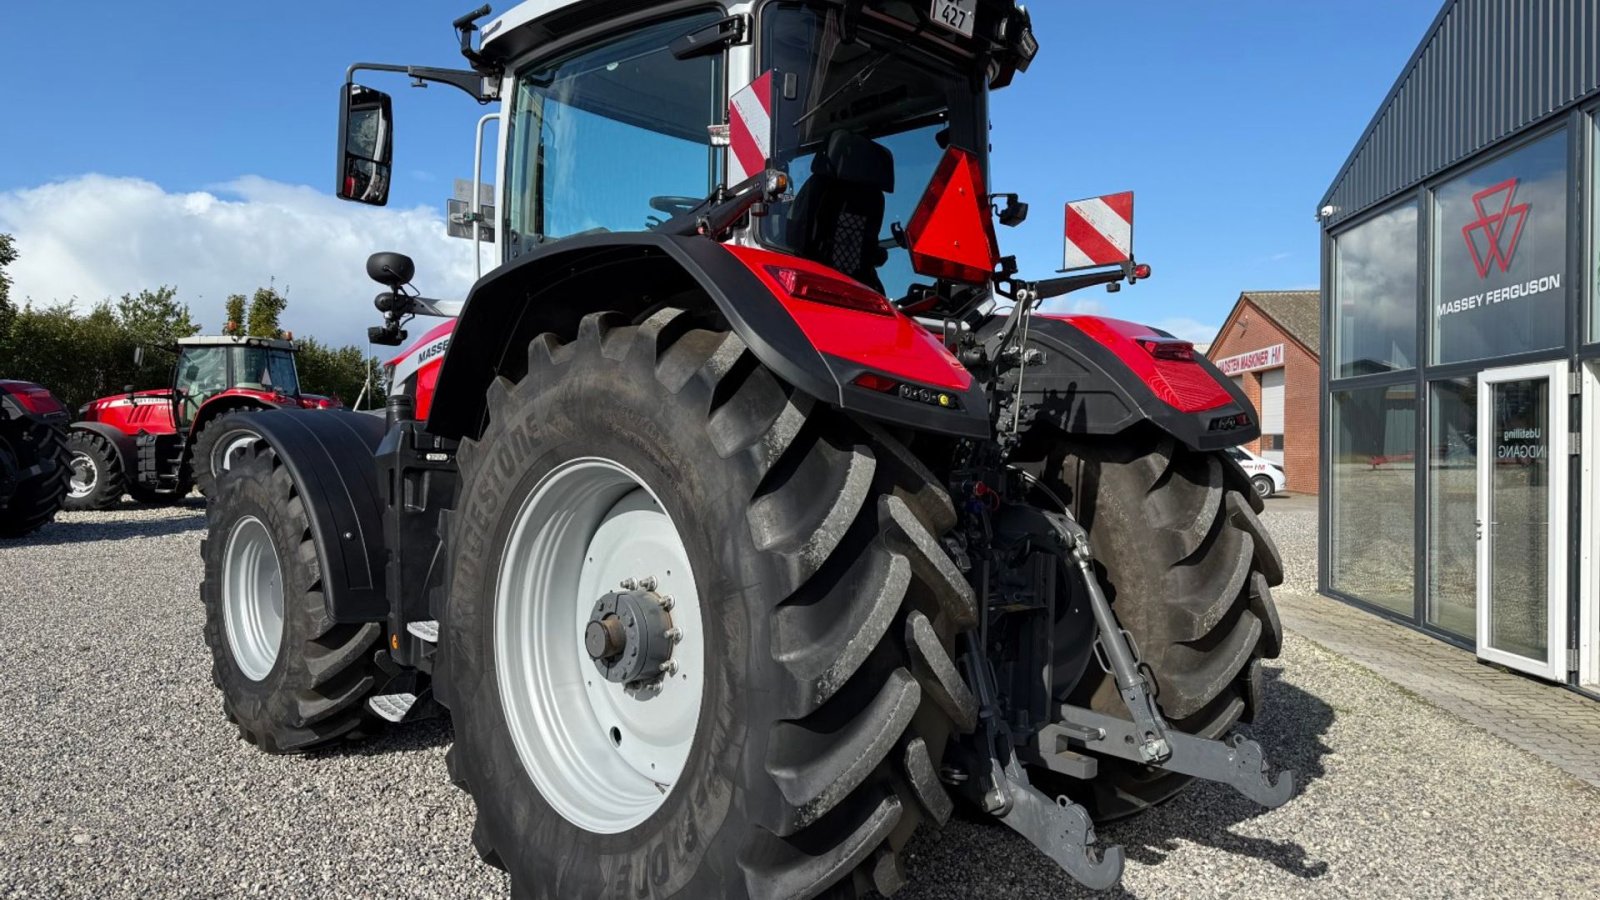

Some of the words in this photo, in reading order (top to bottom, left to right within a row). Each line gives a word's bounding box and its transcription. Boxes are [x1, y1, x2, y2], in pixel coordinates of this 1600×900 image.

[941, 4, 966, 29] 427
[1436, 292, 1485, 317] MASSEY
[1486, 274, 1560, 305] FERGUSON
[1271, 345, 1282, 364] HM
